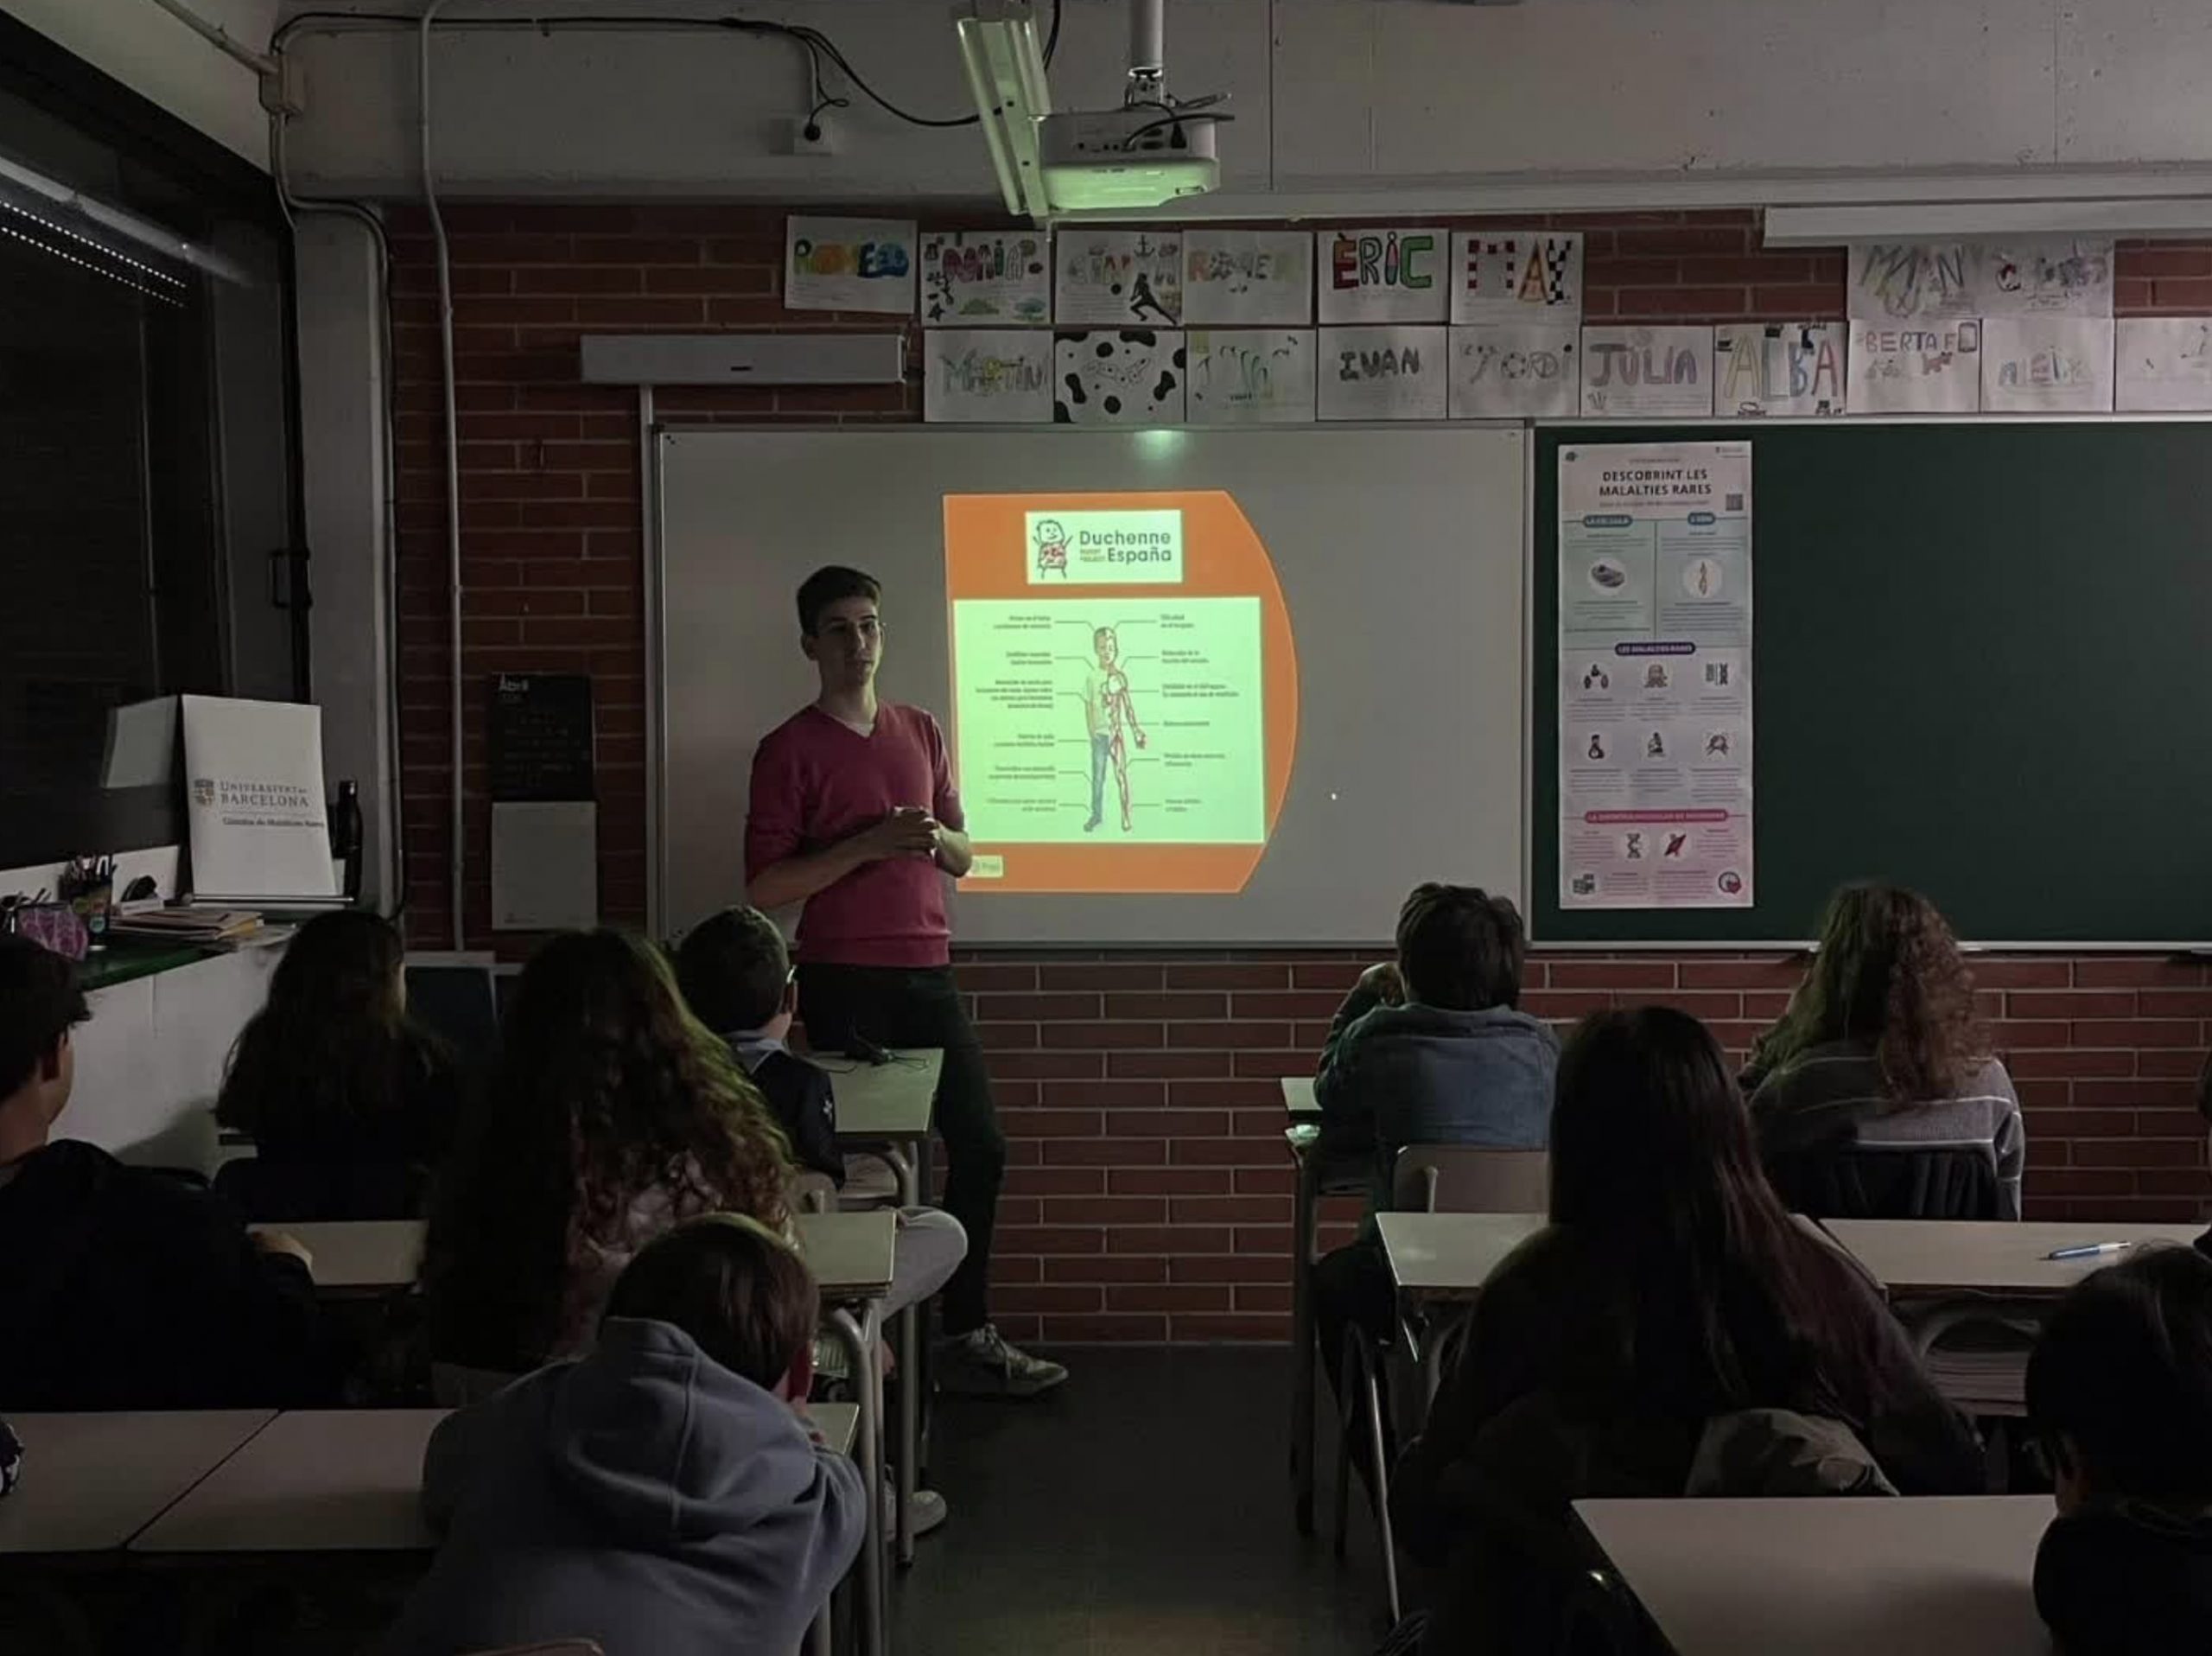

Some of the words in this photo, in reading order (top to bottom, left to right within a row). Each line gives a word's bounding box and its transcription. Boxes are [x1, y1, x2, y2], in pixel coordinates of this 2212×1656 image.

[1339, 346, 1420, 381] IVAN
[1724, 333, 1838, 402] ALBA
[1602, 469, 1682, 482] DESCOBRINT
[1687, 468, 1708, 481] LES
[1599, 485, 1669, 496] MALALTIES
[1672, 484, 1712, 495] RARES
[1079, 529, 1171, 545] Duchenne
[1108, 546, 1172, 565] España
[220, 793, 309, 807] BARCELONA
